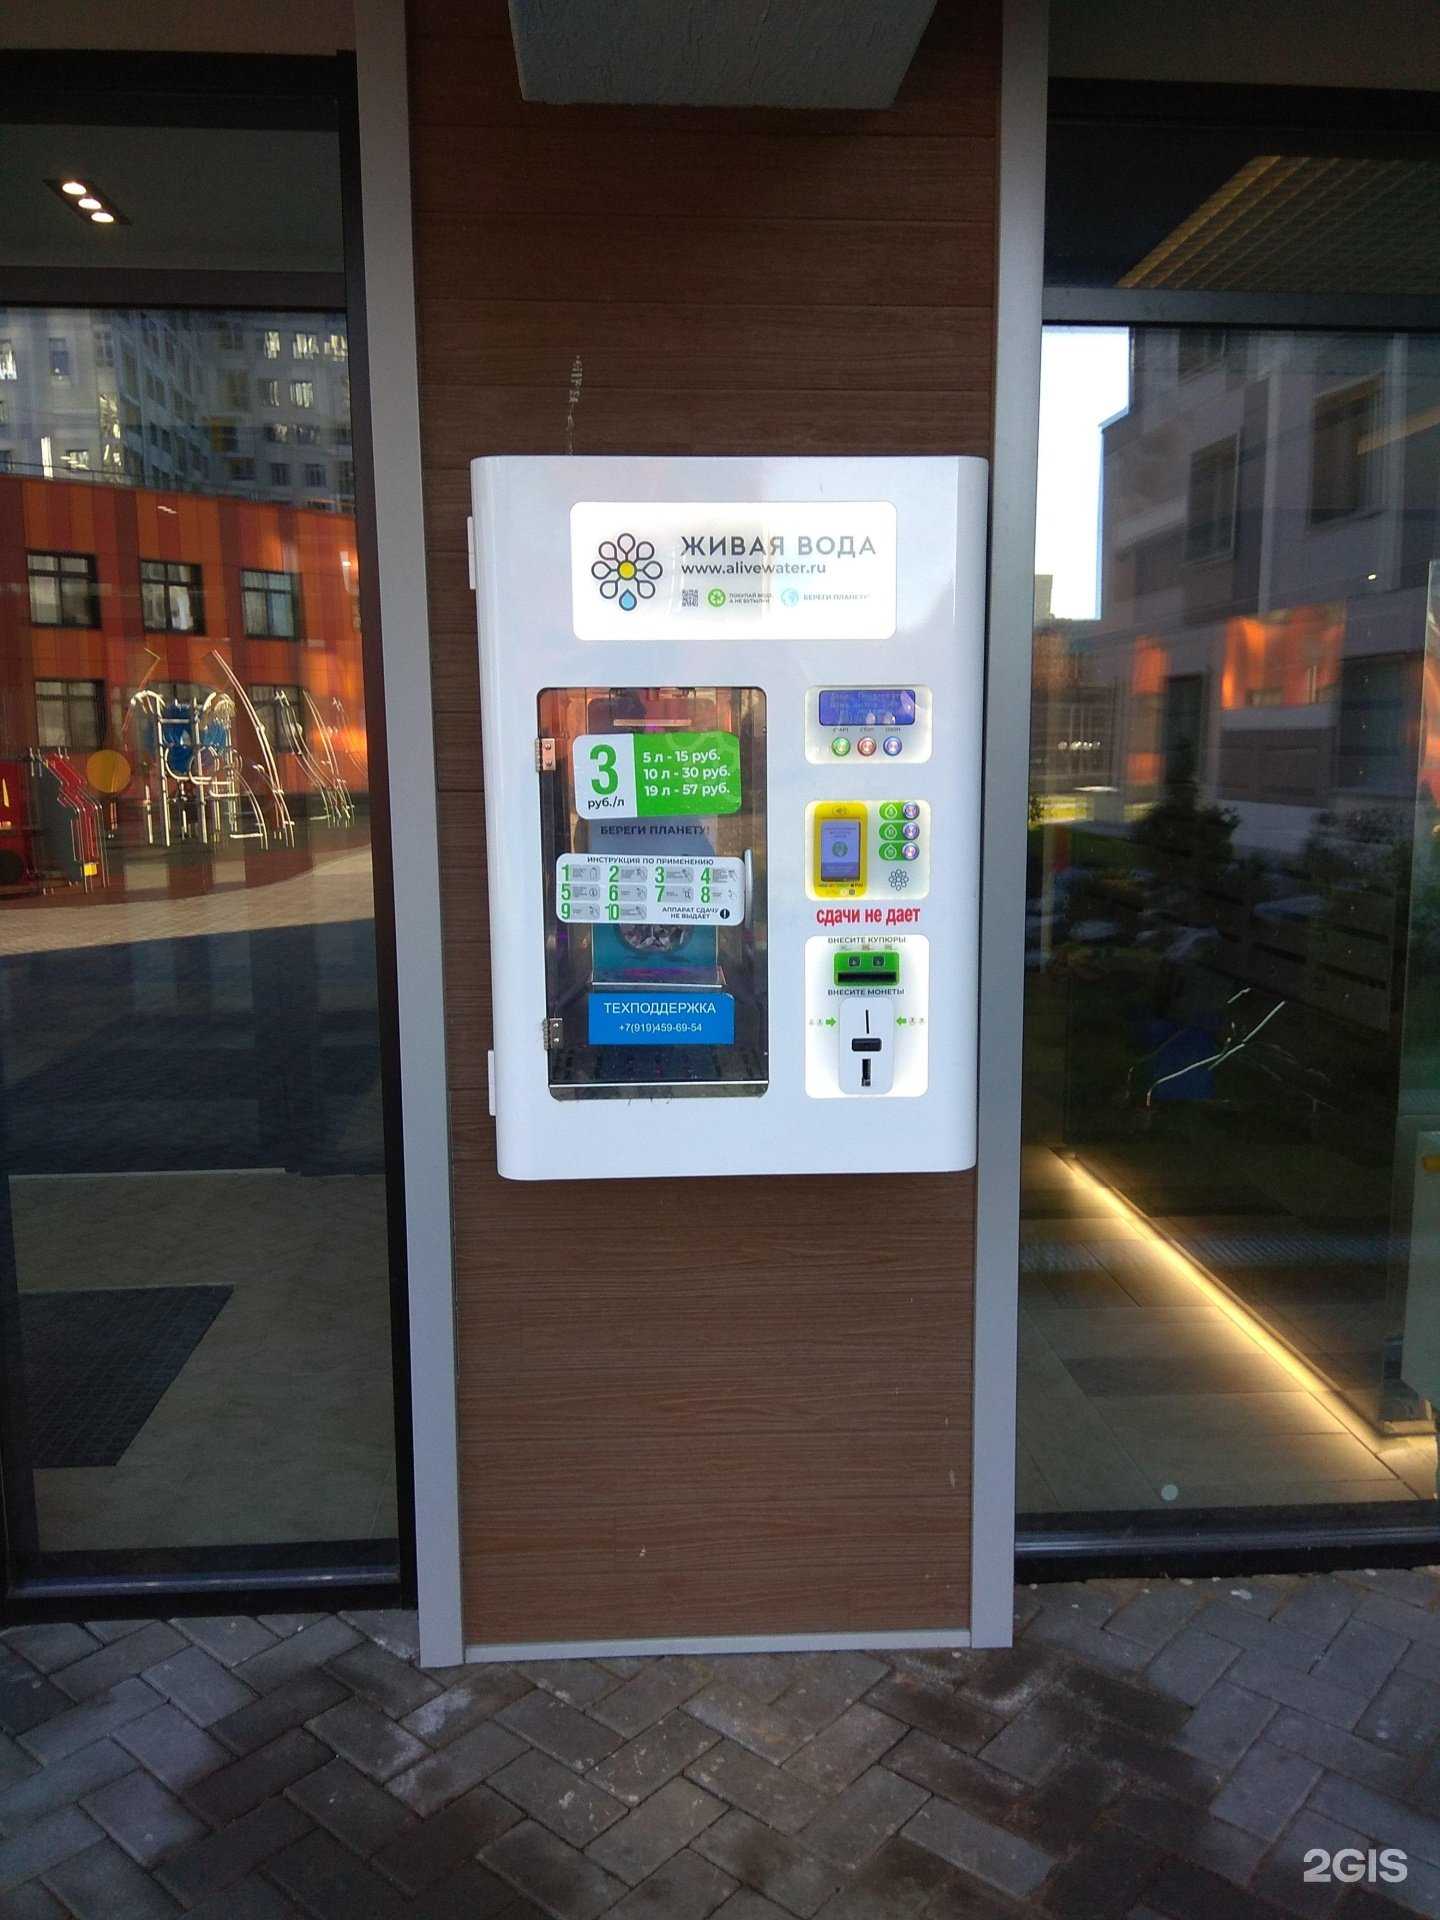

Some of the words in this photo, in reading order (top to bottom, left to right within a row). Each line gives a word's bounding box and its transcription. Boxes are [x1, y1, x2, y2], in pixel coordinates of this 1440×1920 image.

[680, 536, 785, 557] ЖИВАЯ
[798, 536, 877, 559] ВОДА
[681, 561, 826, 575] www.alivewater.ru
[643, 752, 651, 763] 5
[654, 753, 663, 762] л
[675, 751, 689, 761] 15
[692, 749, 721, 763] руб.
[590, 744, 619, 795] 3
[644, 769, 658, 779] 10
[661, 770, 670, 779] л
[682, 767, 699, 778] 30
[703, 765, 731, 780] руб.
[645, 786, 658, 796] 19
[662, 786, 671, 795] л
[683, 784, 698, 795] 57
[702, 783, 730, 797] руб.
[588, 796, 625, 810] руб./л
[600, 825, 646, 835] БЕРЕГИ
[657, 858, 714, 866] ПРИМЕНЕНИЮ
[562, 864, 569, 881] 1
[609, 865, 619, 882] 2
[655, 866, 665, 883] 3
[701, 867, 711, 884] 4
[561, 883, 571, 900] 5
[609, 884, 618, 901] 6
[655, 885, 665, 902] 7
[701, 886, 710, 903] 8
[561, 903, 571, 920] 9
[605, 903, 619, 920] 10
[816, 909, 860, 926] сдачи
[865, 909, 882, 923] не
[886, 908, 921, 925] дает
[868, 988, 904, 996] МОНЕТЫ
[603, 1002, 716, 1016] ТЕХПОДДЕРЖКА
